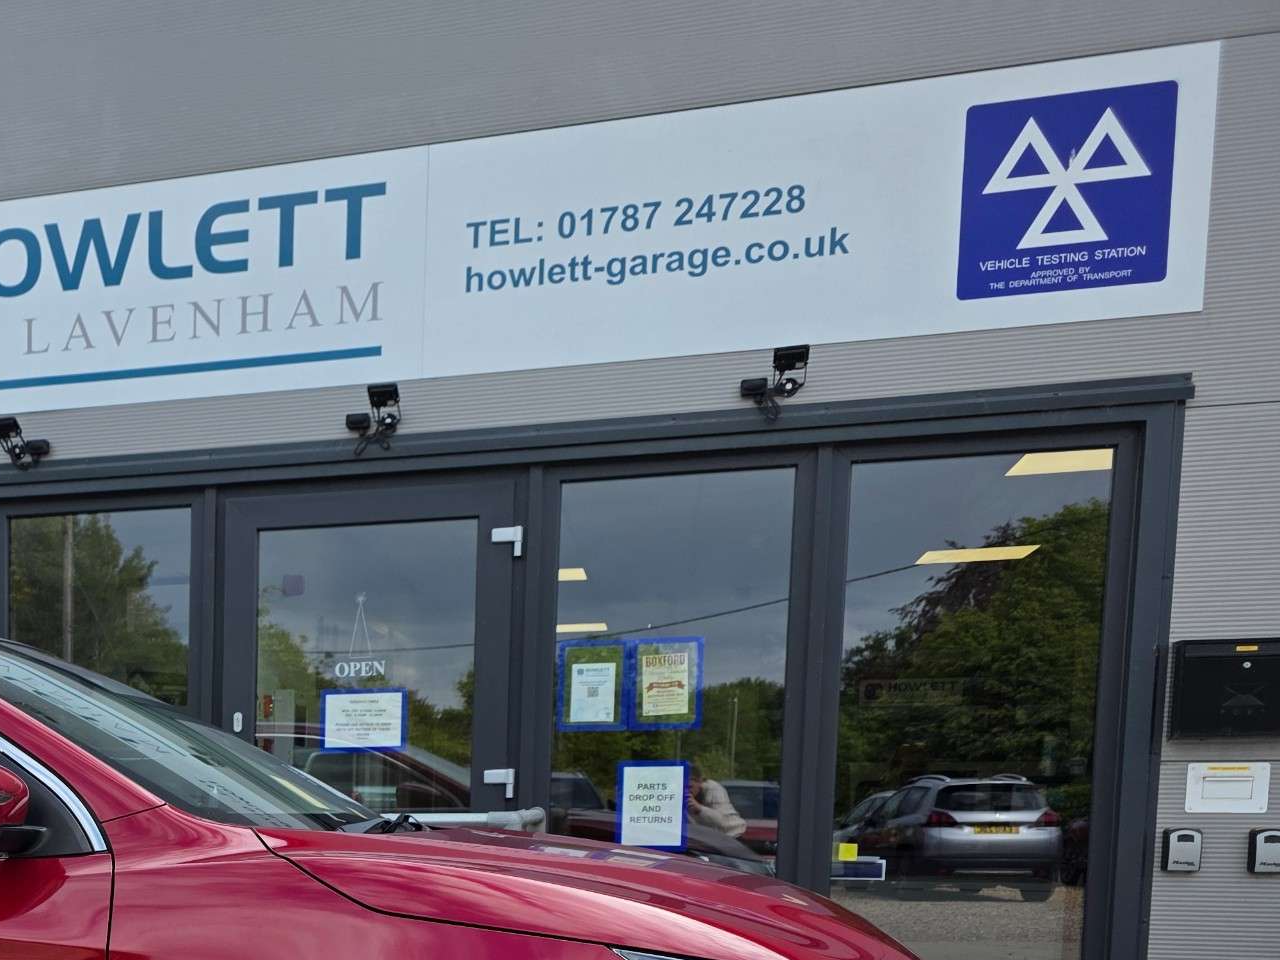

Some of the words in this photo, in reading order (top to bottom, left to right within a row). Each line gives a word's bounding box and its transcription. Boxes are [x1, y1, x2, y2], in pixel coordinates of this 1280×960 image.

[466, 216, 544, 248] TEL:
[557, 201, 662, 239] 01787
[673, 184, 806, 226] 247228
[465, 226, 850, 293] howlett-garage.co.uk
[979, 257, 1031, 272] VEHICLE
[1036, 251, 1089, 266] TESTING
[1094, 245, 1147, 260] STATION
[989, 282, 1005, 290] THE
[1009, 277, 1063, 289] DEPARTMENT
[1083, 269, 1133, 281] TRANSPORT
[1030, 267, 1075, 278] APPROVED
[1079, 266, 1091, 274] BY
[24, 281, 384, 356] LAVENHAM
[335, 660, 387, 678] OPEN
[636, 783, 668, 791] PARTS
[657, 793, 676, 801] OFF
[641, 805, 661, 813] AND
[629, 816, 673, 824] RETURNS
